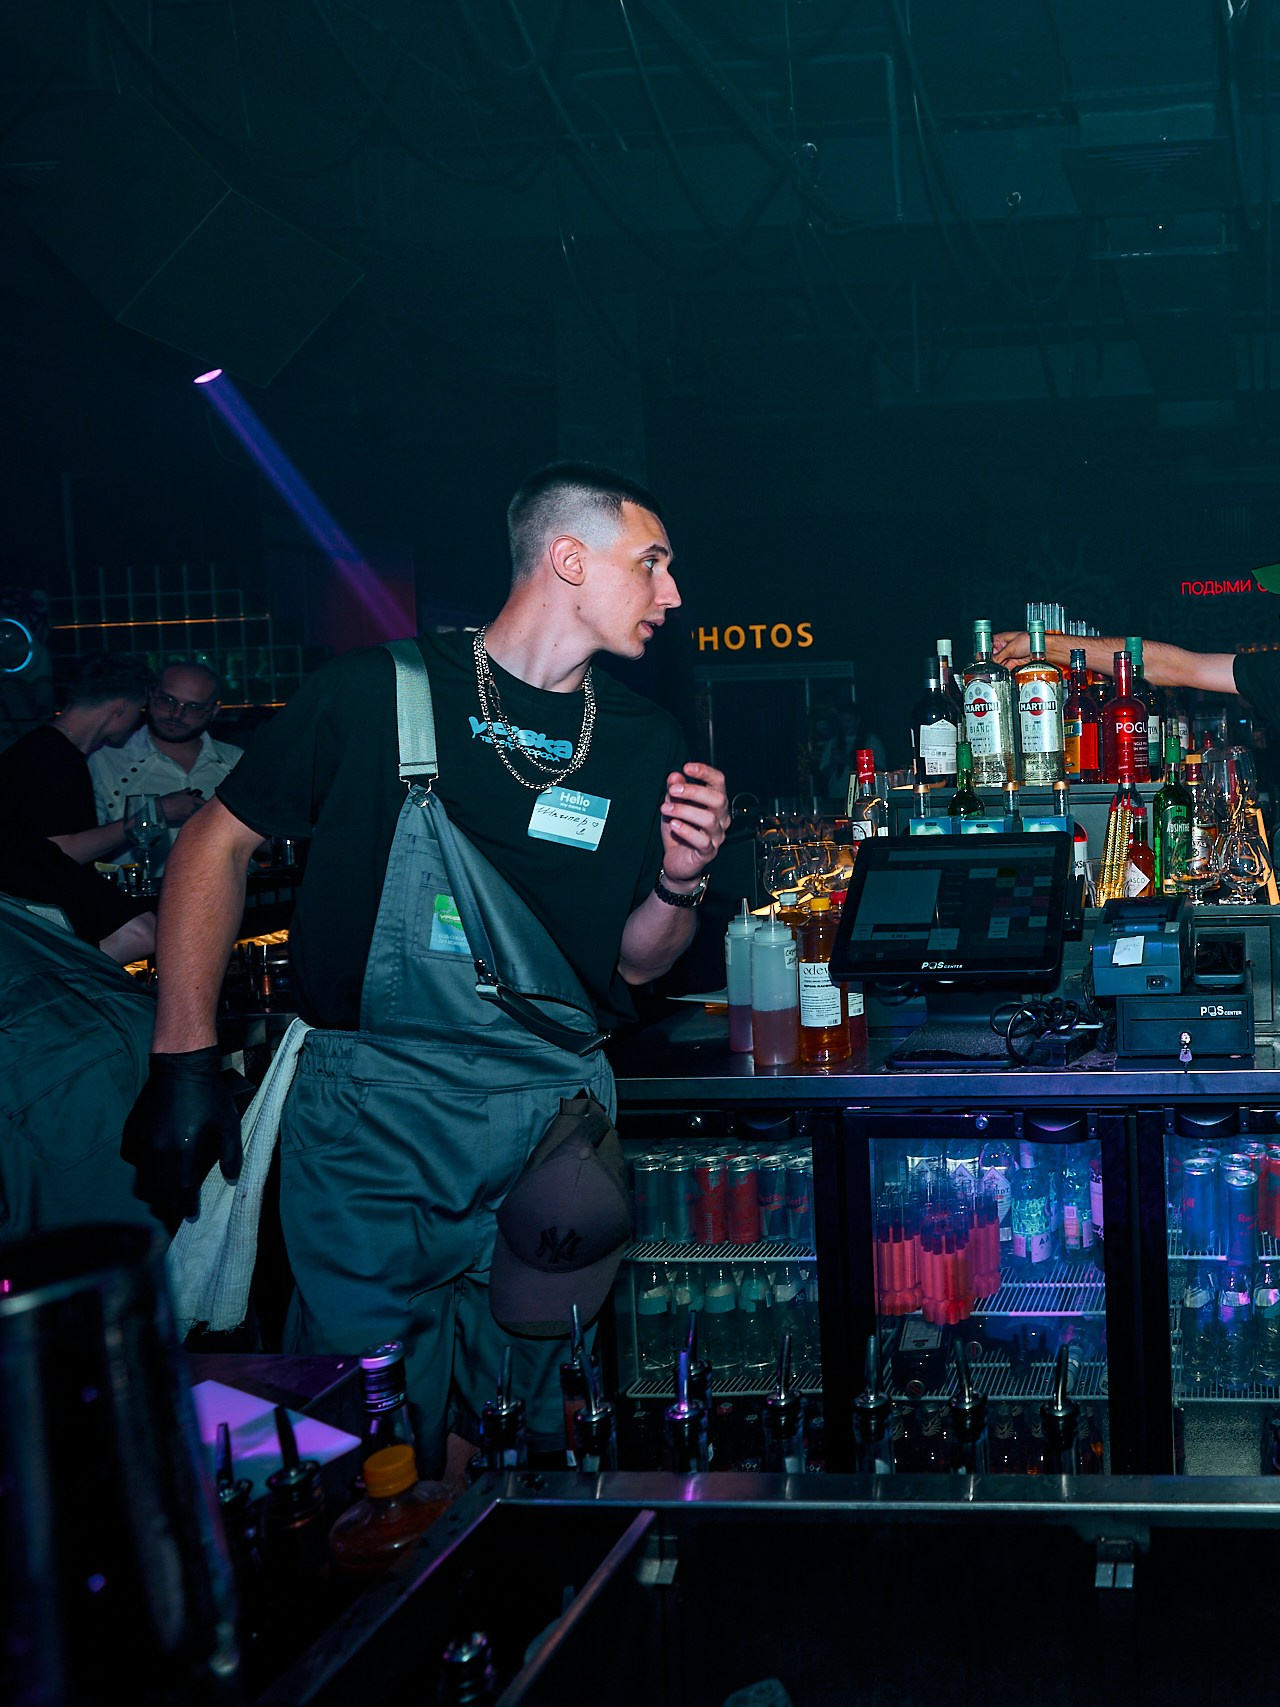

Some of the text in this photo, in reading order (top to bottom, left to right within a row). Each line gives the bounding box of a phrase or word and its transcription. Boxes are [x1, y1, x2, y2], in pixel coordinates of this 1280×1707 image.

[1180, 578, 1253, 596] ПОДЫМИ
[690, 621, 815, 652] HOTOS
[965, 701, 999, 713] MARTINI
[1020, 701, 1056, 712] MARTINI
[559, 791, 591, 808] Hello
[535, 1226, 582, 1265] NY
